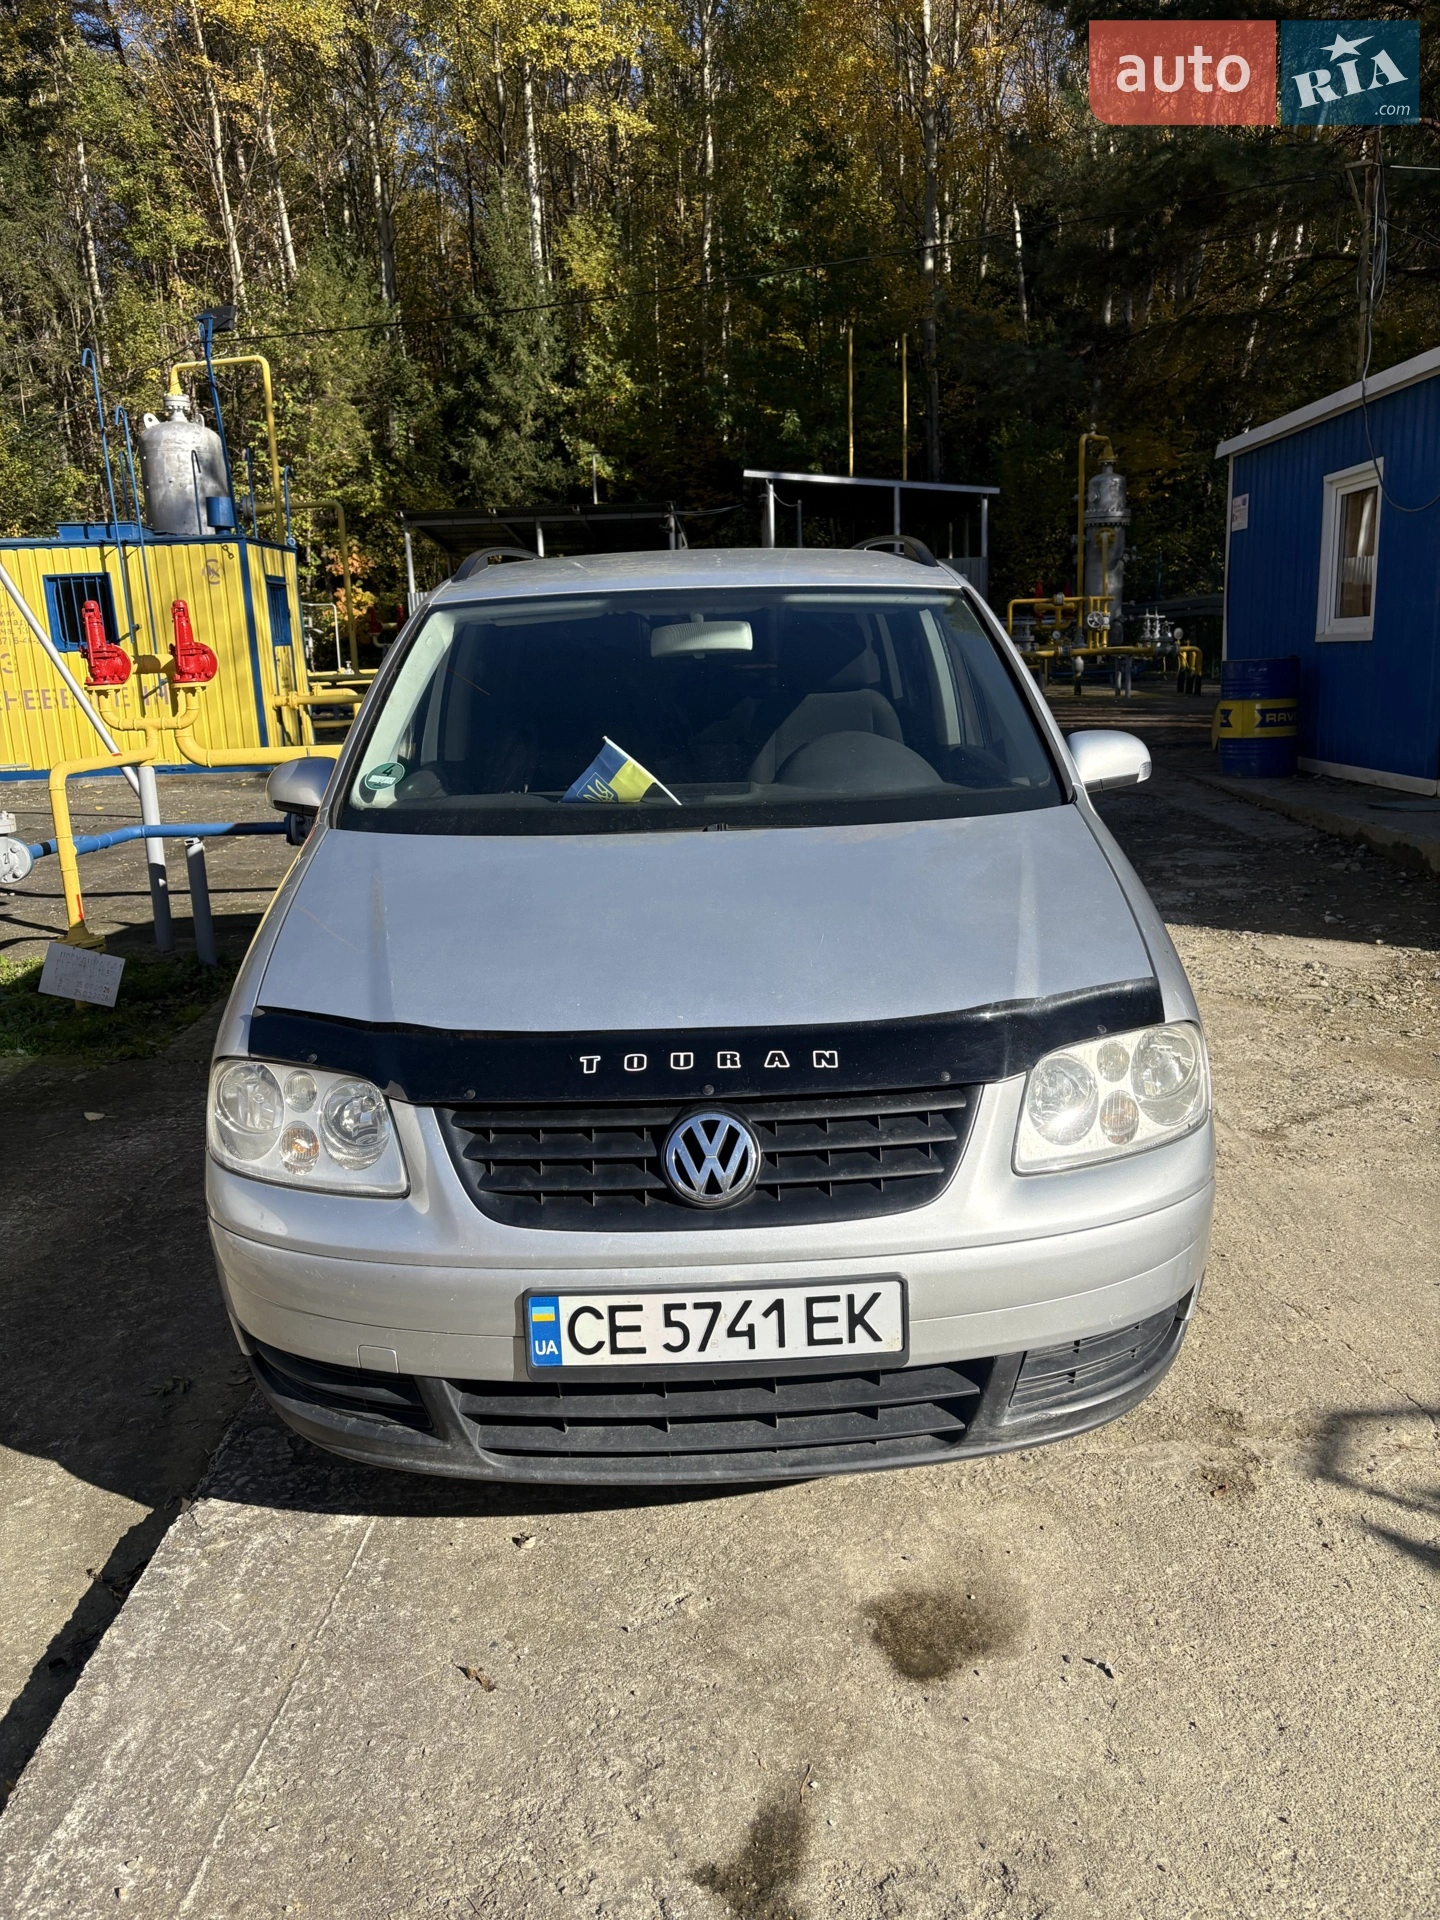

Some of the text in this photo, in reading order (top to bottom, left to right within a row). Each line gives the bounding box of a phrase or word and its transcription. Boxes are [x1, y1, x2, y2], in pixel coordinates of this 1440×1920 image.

[580, 1050, 839, 1074] TOURAN
[567, 1291, 882, 1355] CE 5741 EK
[535, 1339, 559, 1355] UA
